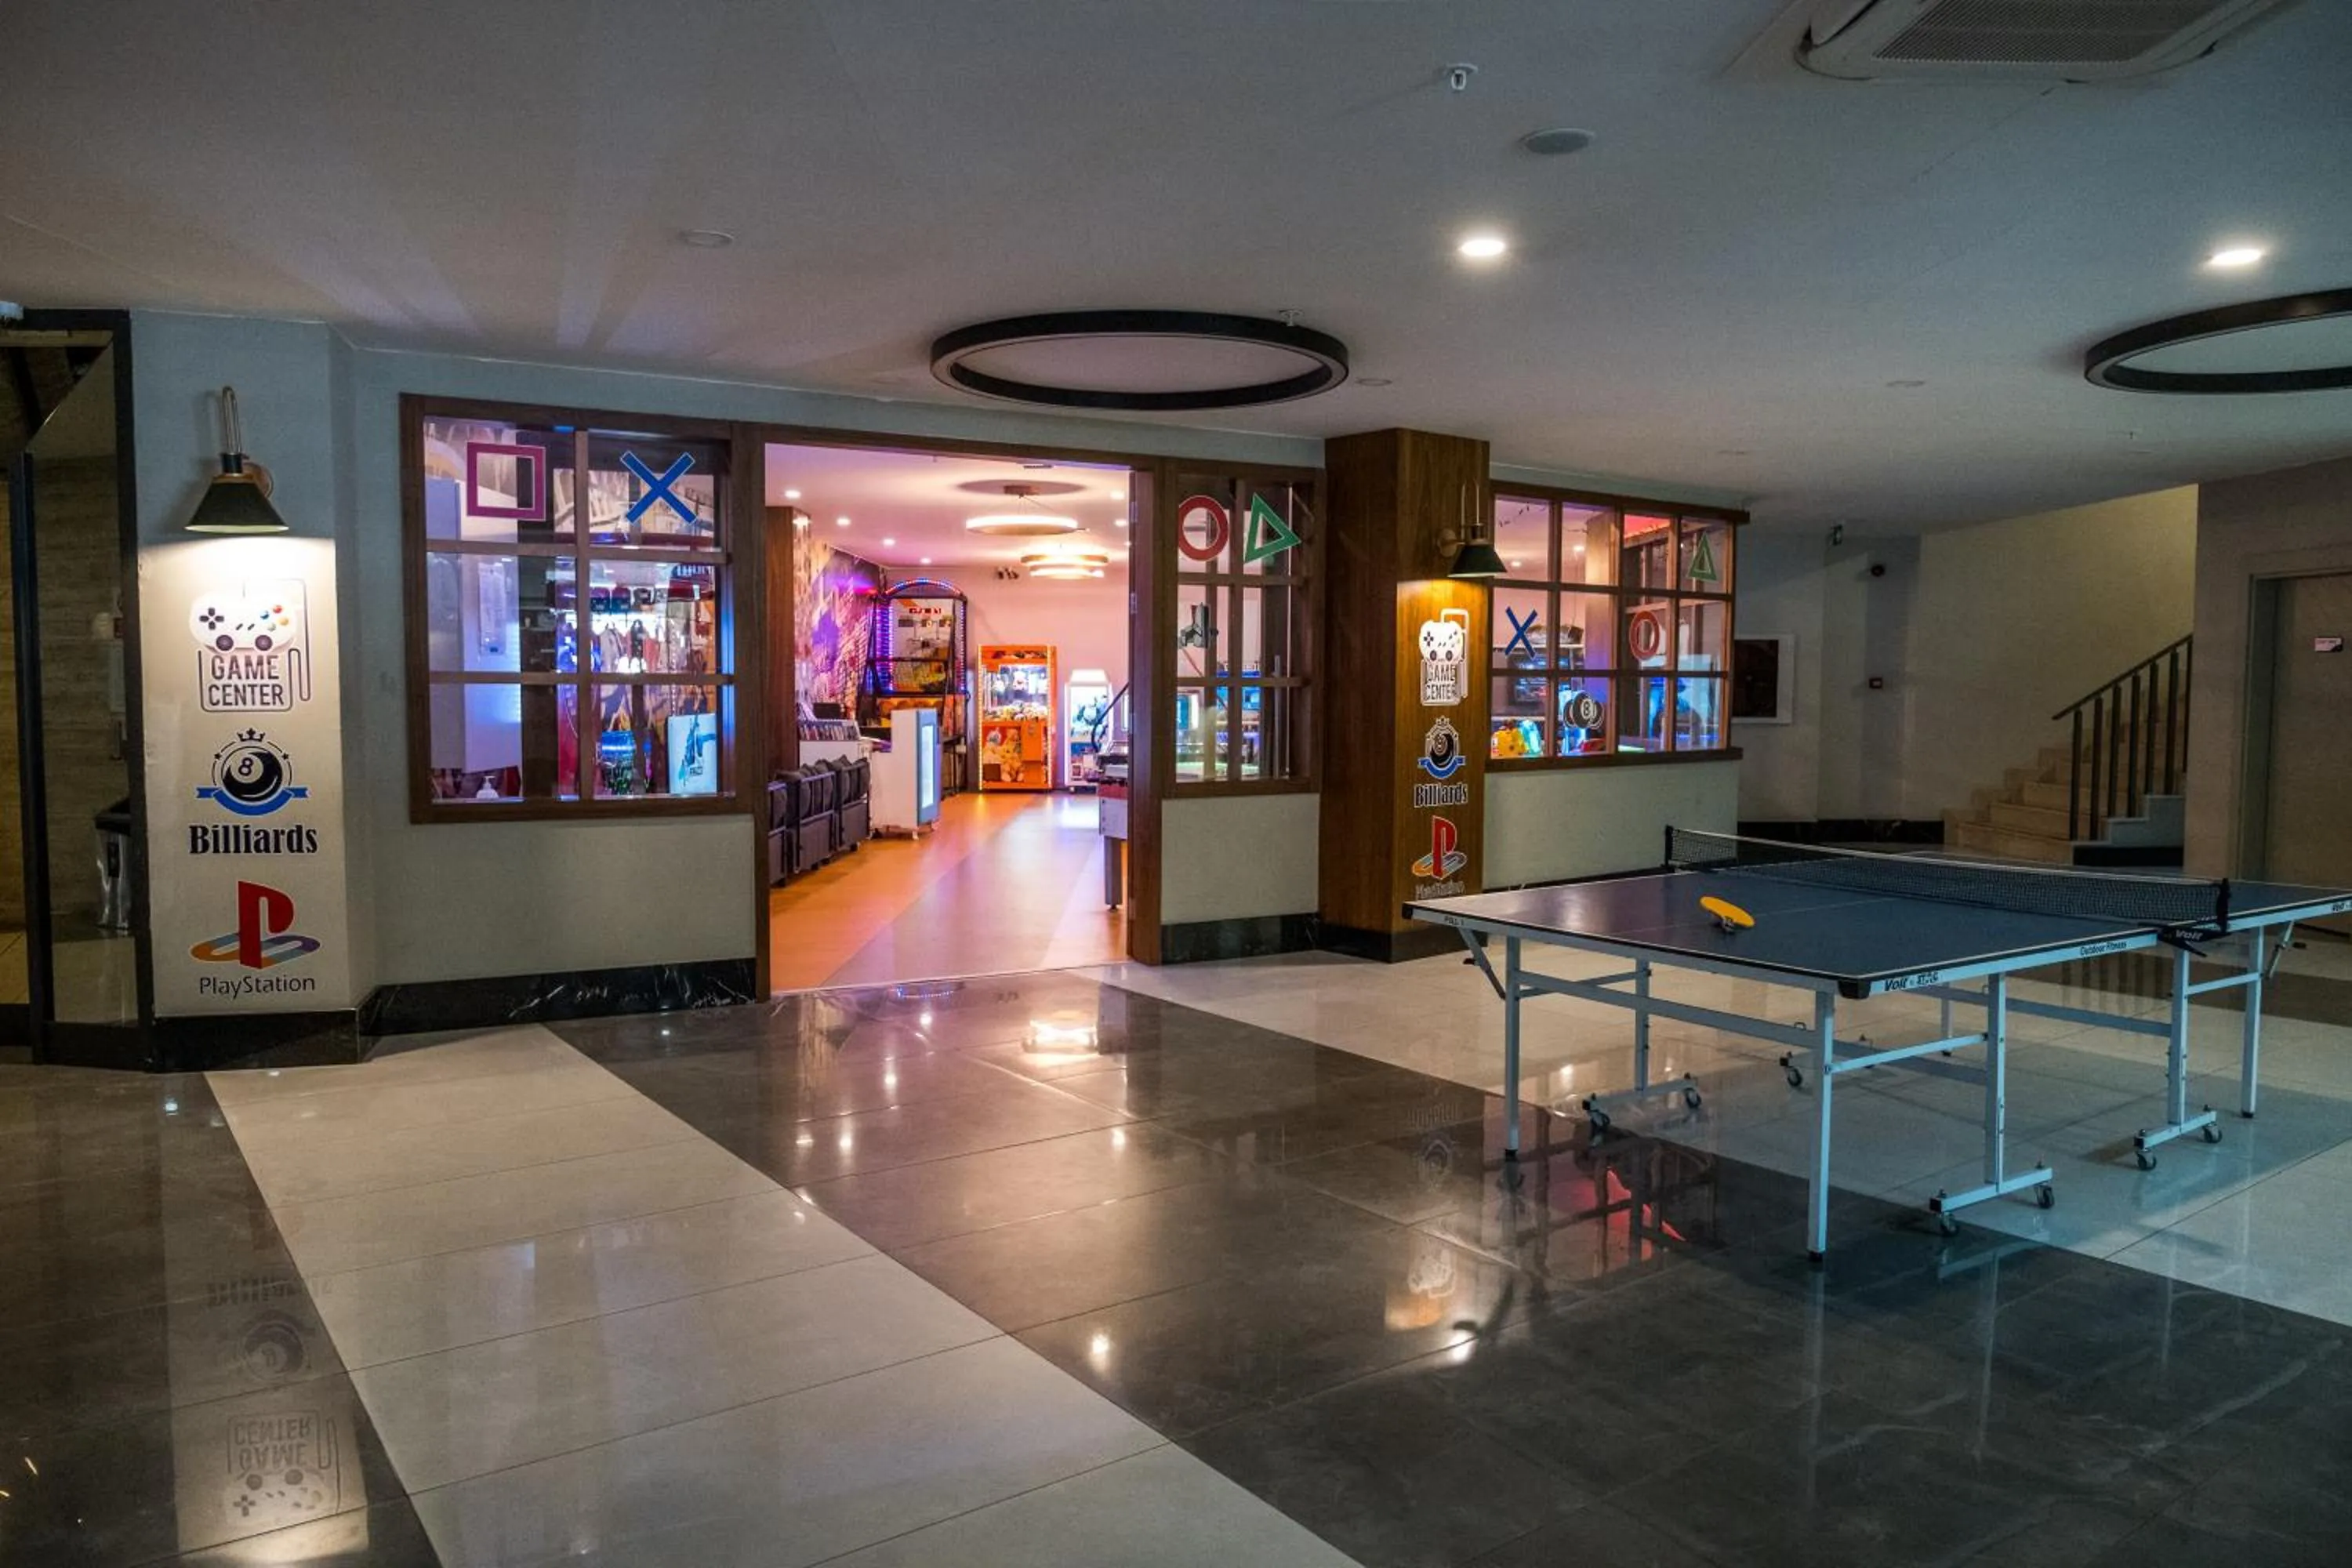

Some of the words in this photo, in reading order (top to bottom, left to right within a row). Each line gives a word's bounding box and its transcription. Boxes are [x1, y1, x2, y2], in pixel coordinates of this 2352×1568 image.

[210, 654, 280, 681] GAME
[207, 683, 285, 706] CENTER
[238, 757, 253, 777] 8
[1414, 783, 1468, 808] Billiards
[188, 823, 318, 855] Billiards
[198, 975, 315, 1000] PlayStation
